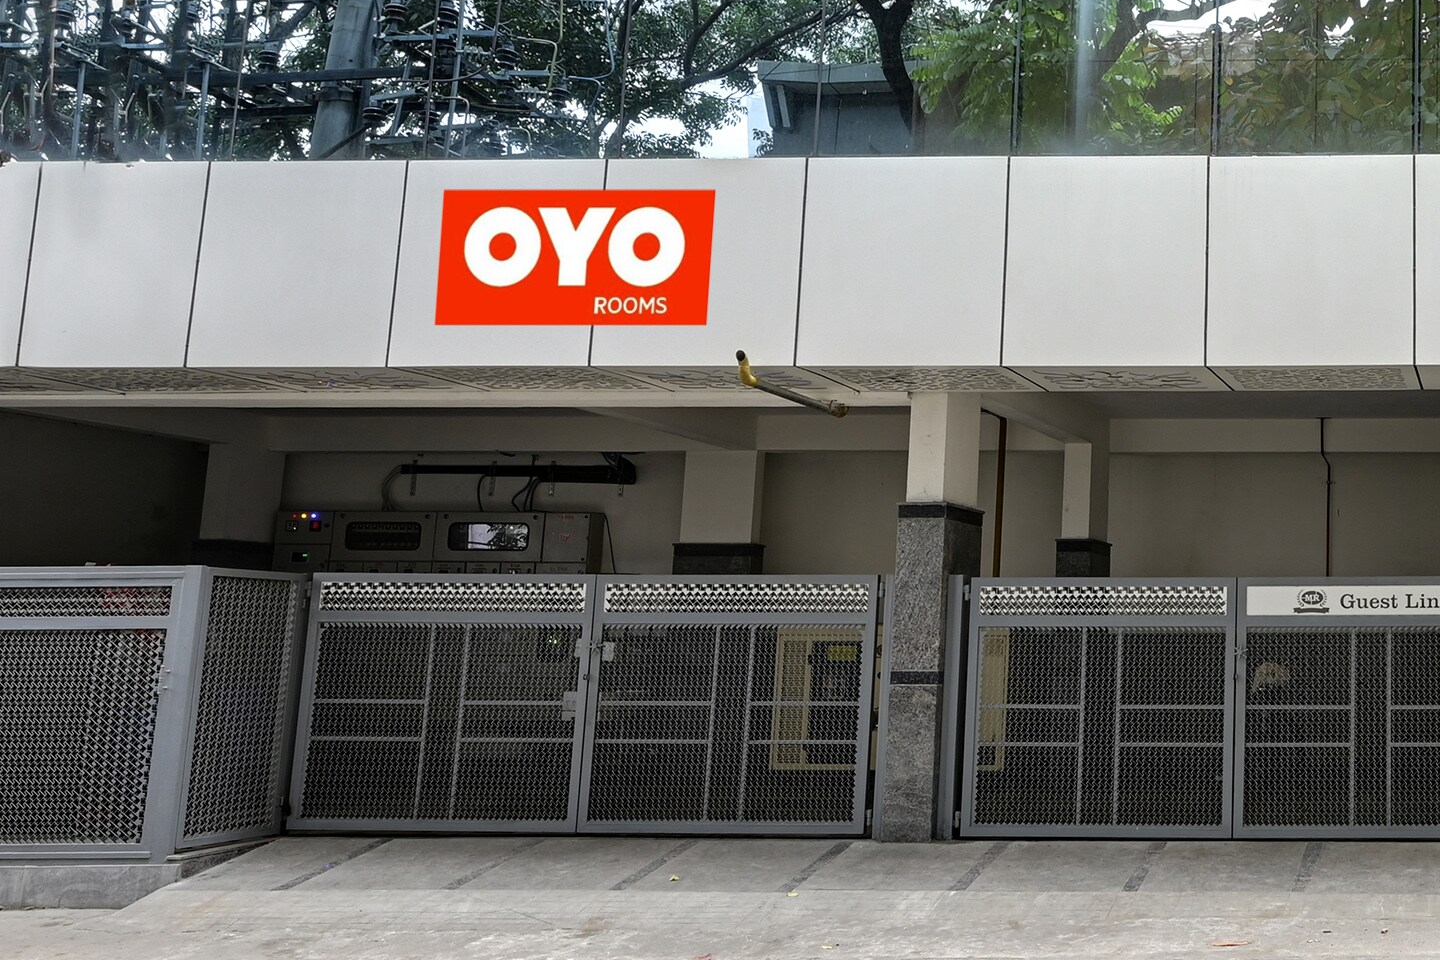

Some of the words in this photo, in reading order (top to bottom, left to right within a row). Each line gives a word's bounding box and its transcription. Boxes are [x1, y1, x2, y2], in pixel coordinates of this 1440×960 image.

[464, 206, 686, 287] OYO
[593, 296, 667, 314] ROOMS
[1305, 594, 1320, 602] MR
[1340, 593, 1398, 609] Guest
